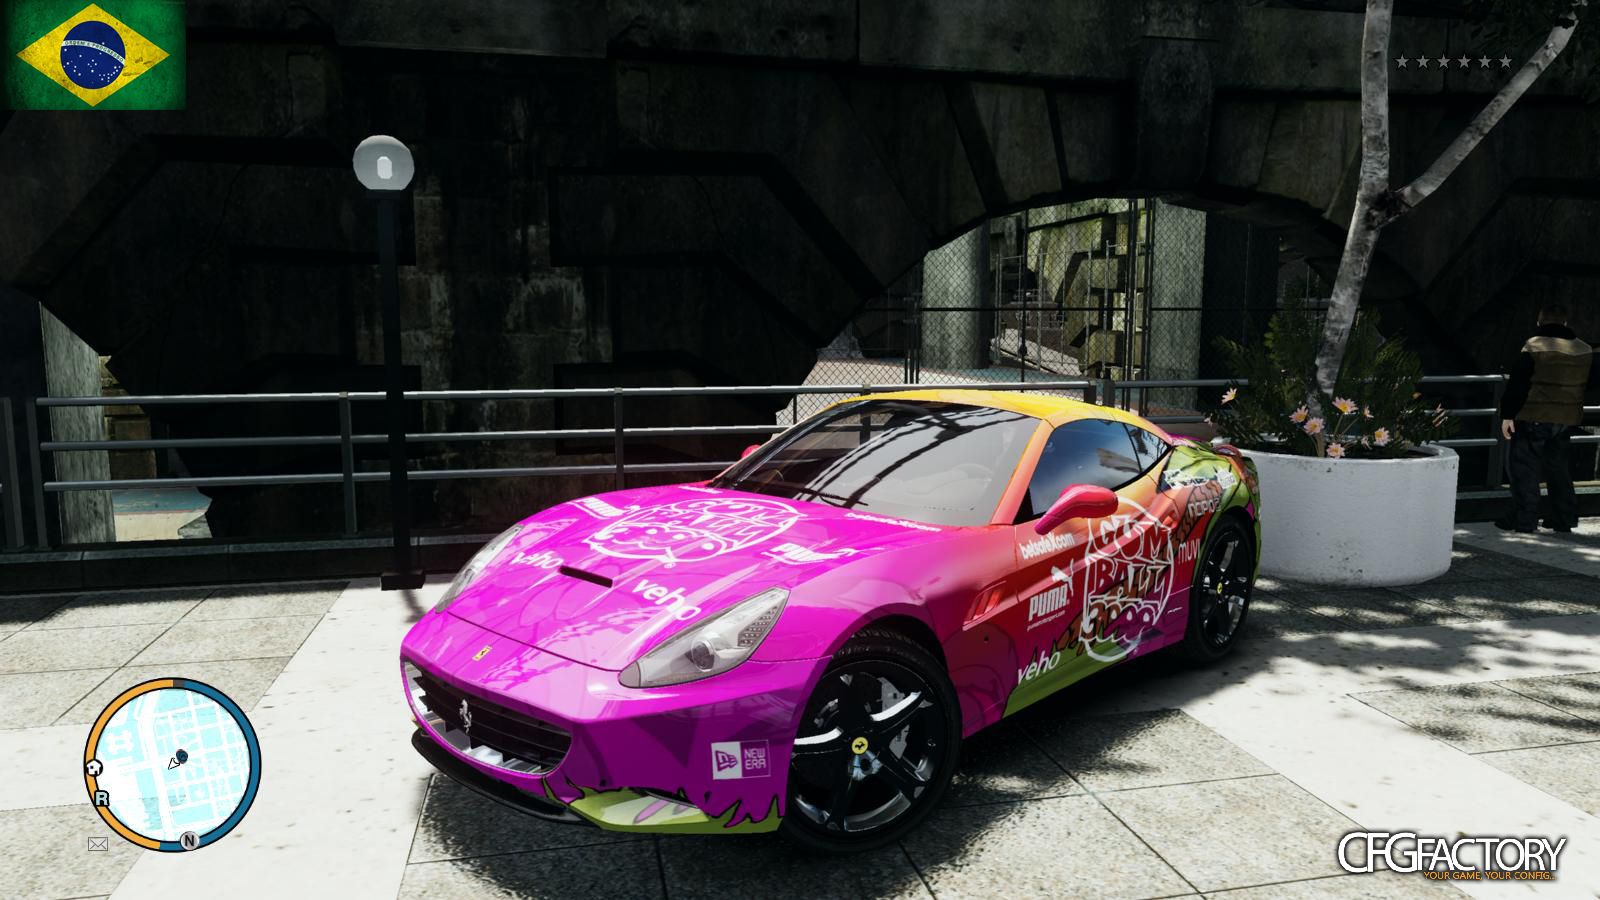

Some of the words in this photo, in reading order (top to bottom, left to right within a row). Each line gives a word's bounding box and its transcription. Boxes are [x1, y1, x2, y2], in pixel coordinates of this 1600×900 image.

[632, 579, 701, 620] veho
[1017, 651, 1061, 684] veho
[744, 748, 766, 759] NEW
[745, 758, 767, 770] ERA
